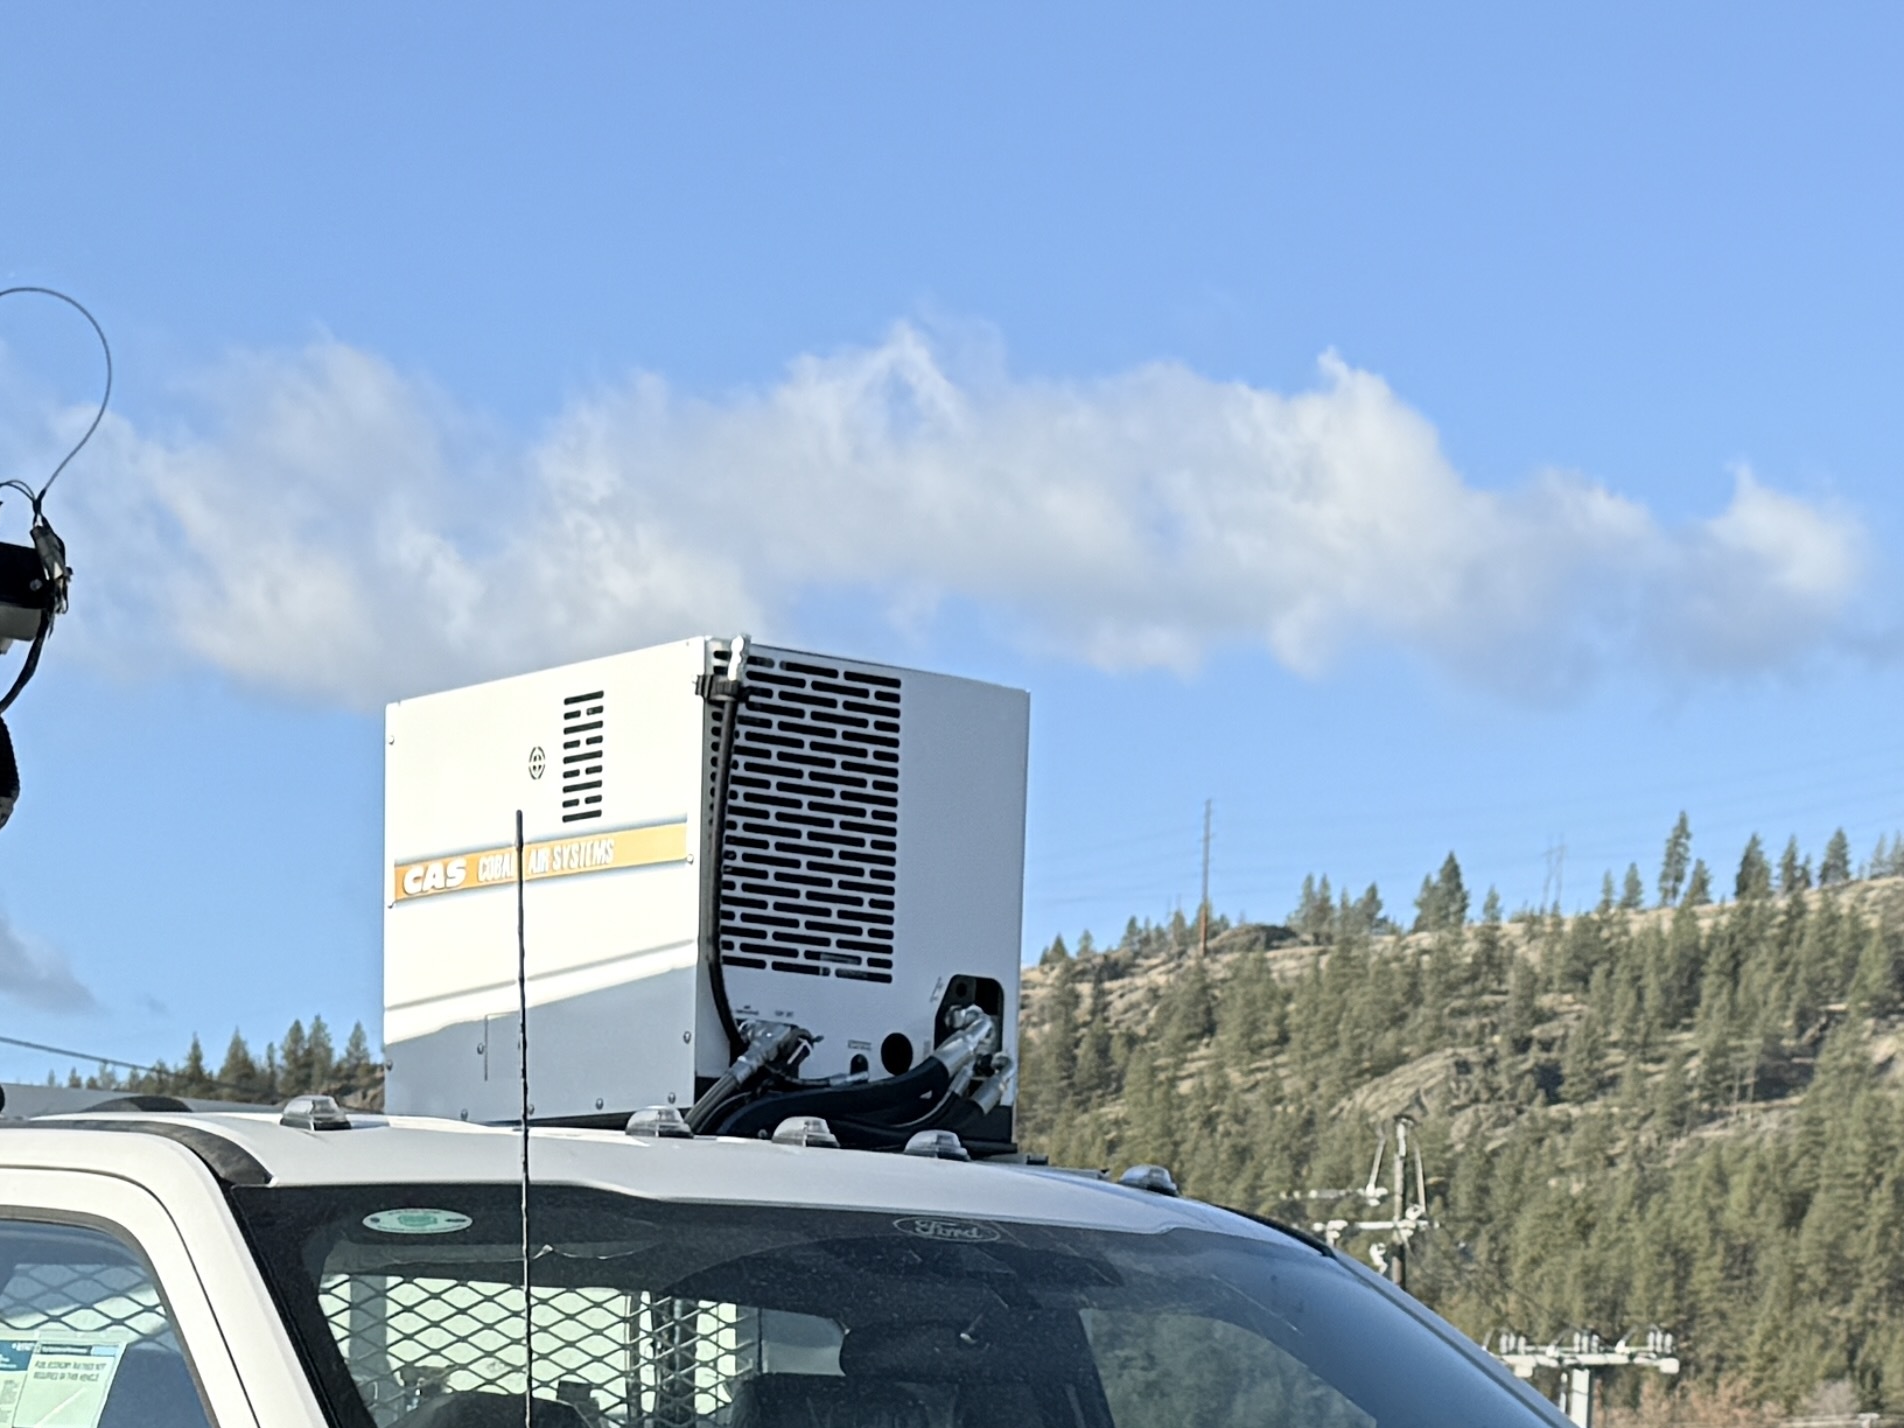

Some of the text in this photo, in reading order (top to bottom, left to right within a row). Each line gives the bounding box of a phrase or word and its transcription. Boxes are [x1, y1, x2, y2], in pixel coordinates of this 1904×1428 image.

[402, 857, 468, 896] CAS
[528, 846, 550, 875] AIR
[552, 838, 615, 870] SYSTEMS
[915, 1219, 984, 1239] Ford
